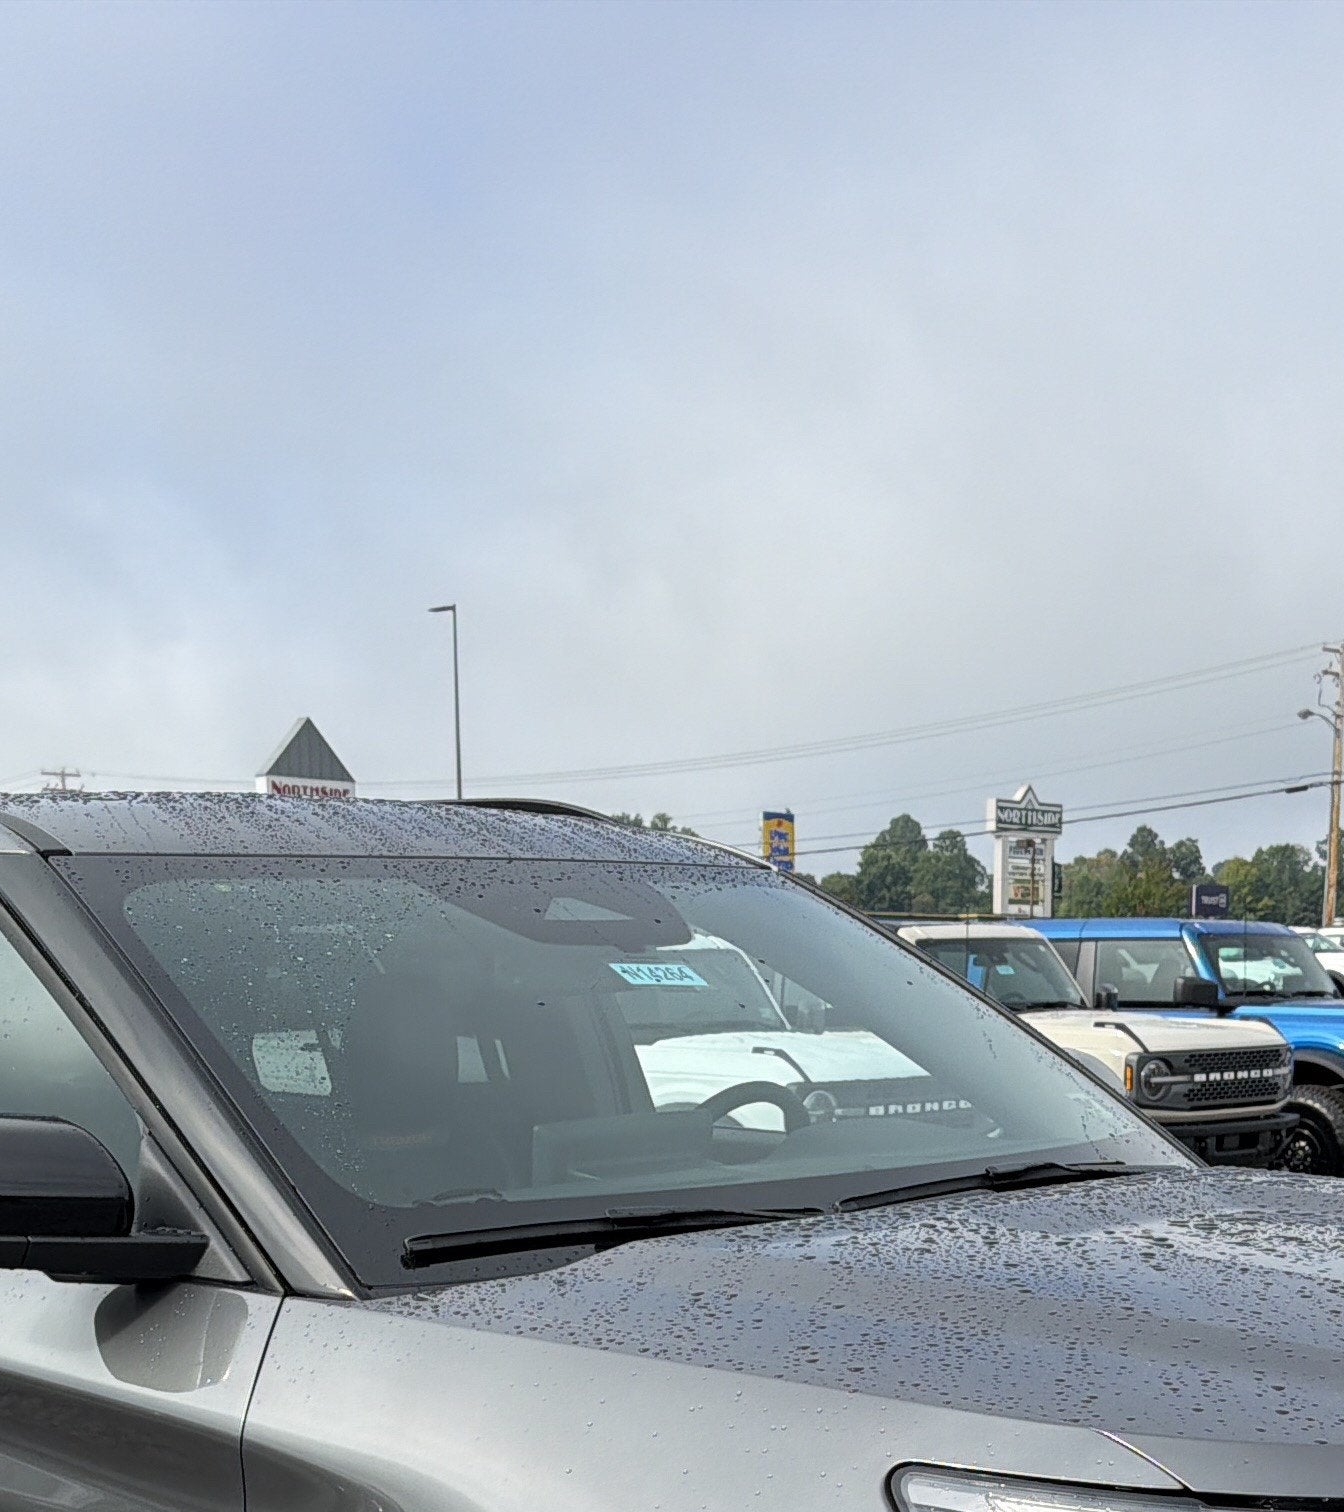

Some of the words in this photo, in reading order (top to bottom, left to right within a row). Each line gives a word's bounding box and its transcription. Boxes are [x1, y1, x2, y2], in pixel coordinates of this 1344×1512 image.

[997, 808, 1061, 827] NORTHSIDE
[1193, 1068, 1274, 1083] BRONCO
[868, 1098, 973, 1117] BRONCO
